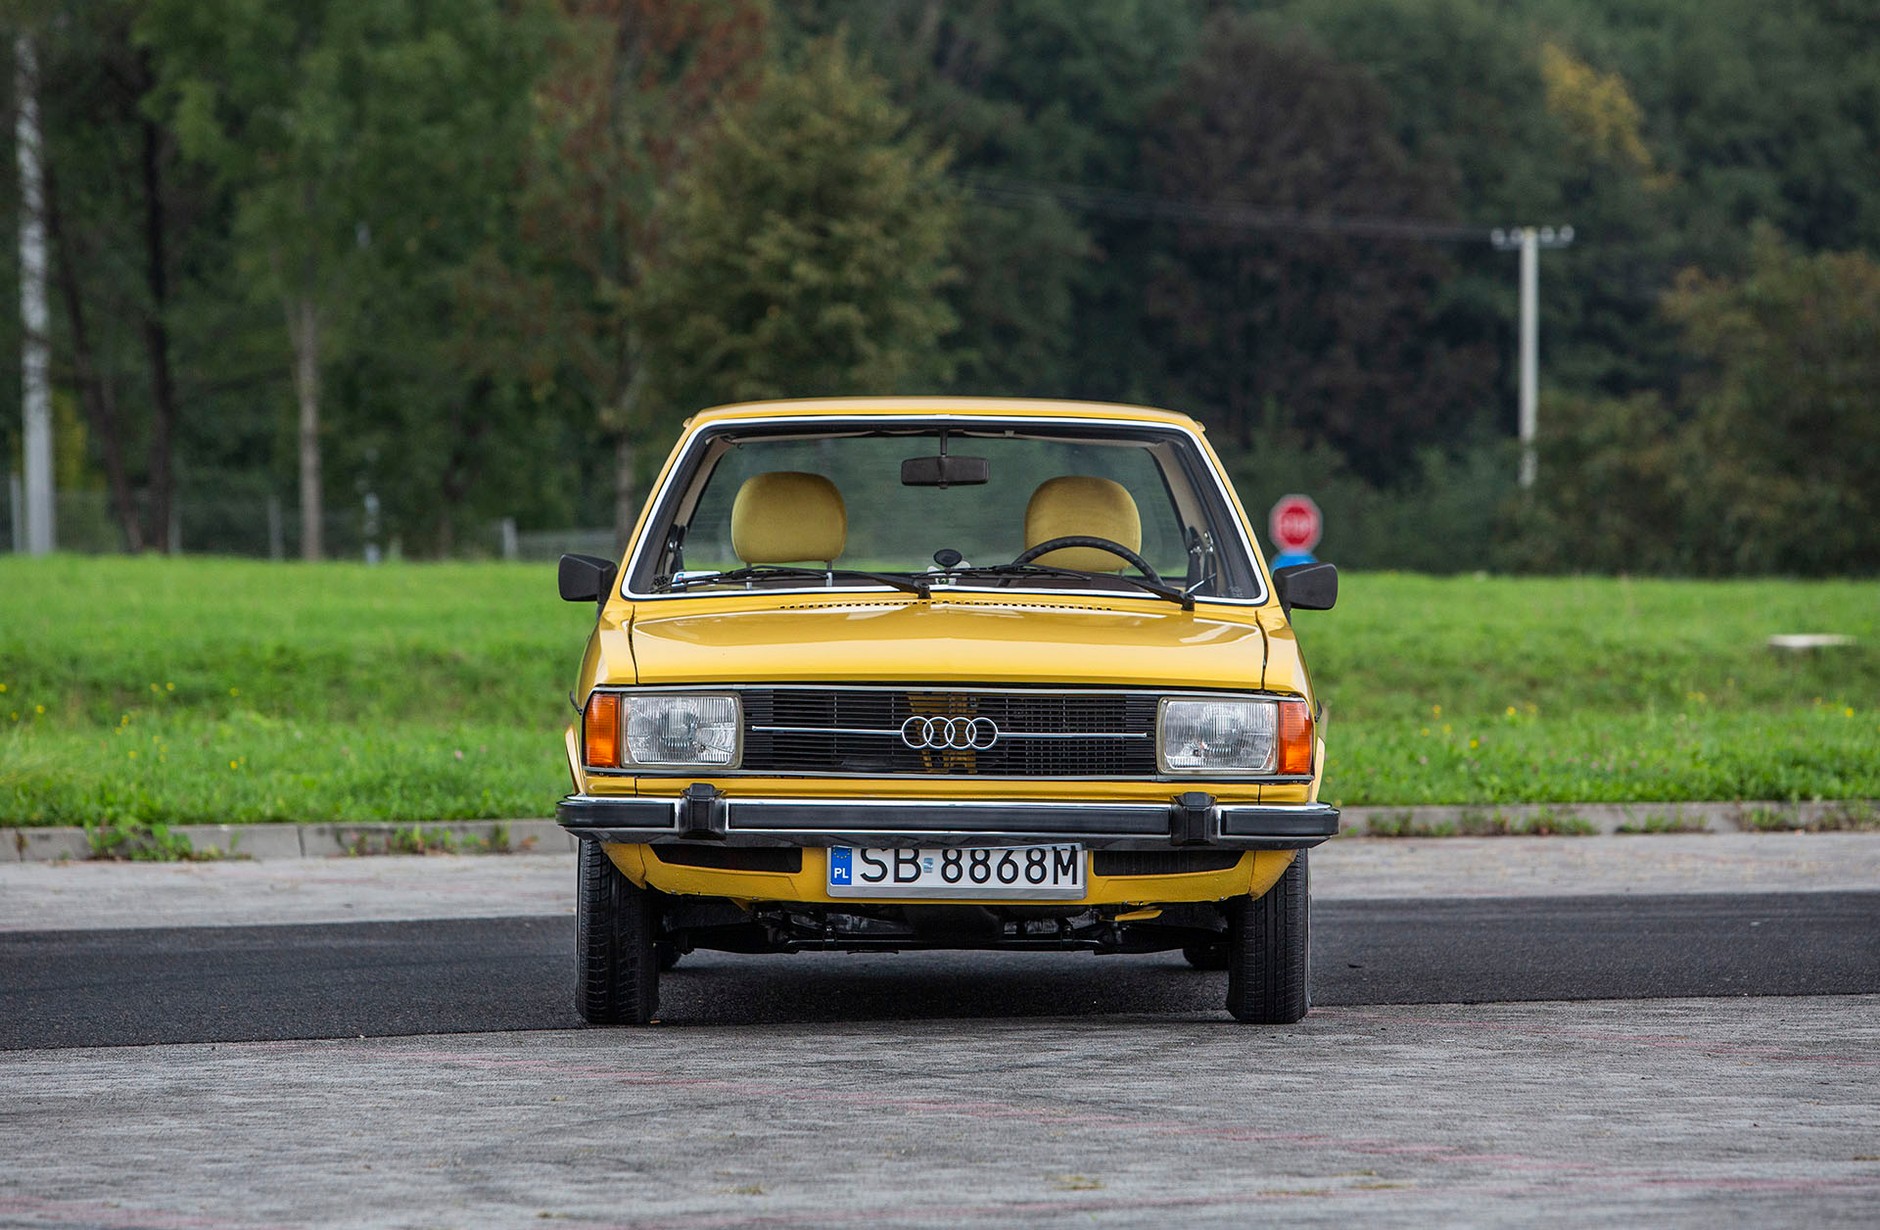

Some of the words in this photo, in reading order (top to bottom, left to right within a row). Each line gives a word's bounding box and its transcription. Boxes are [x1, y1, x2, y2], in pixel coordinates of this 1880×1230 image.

[834, 867, 849, 879] PL
[860, 848, 922, 883] SB
[941, 846, 1077, 885] 8868M
